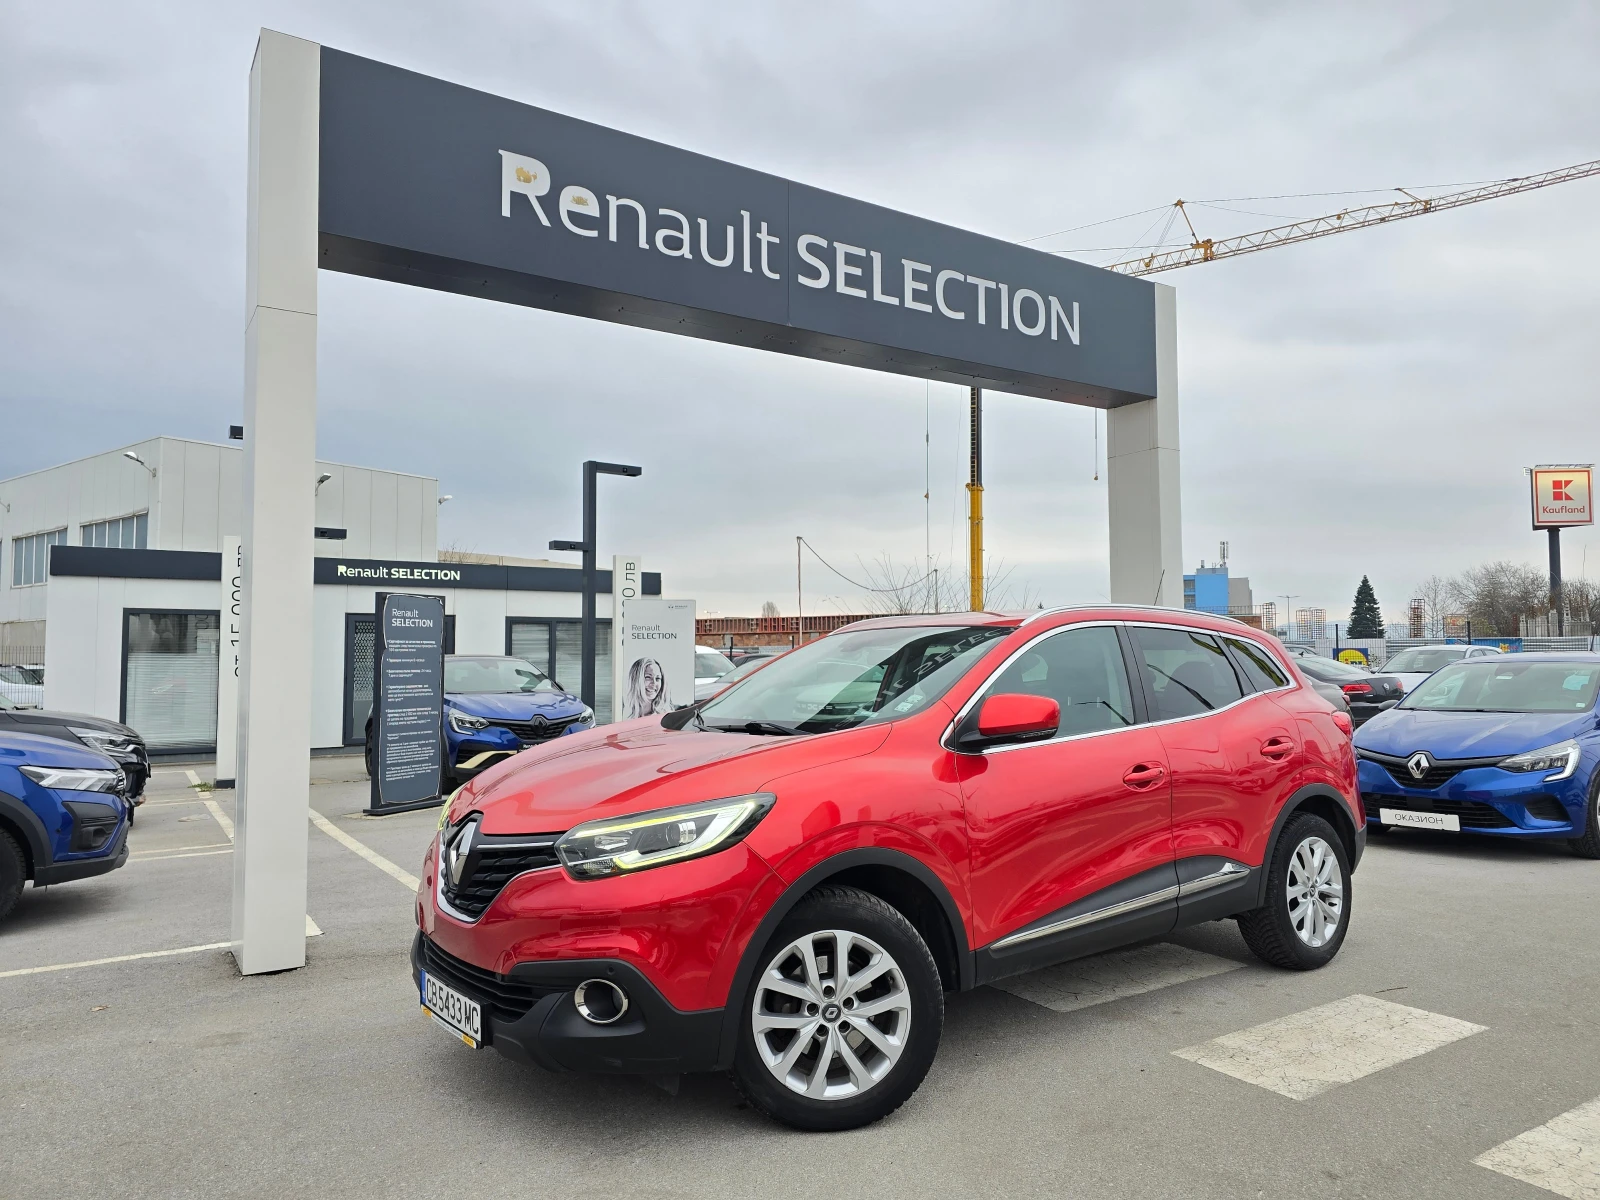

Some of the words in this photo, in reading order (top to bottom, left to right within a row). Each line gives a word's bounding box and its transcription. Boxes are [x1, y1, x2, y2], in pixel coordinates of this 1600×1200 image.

[498, 148, 780, 280] Renault
[796, 234, 1080, 345] SELECTION
[1542, 505, 1585, 514] Kaufland
[337, 564, 389, 578] Renault
[390, 567, 461, 581] SELECTION
[391, 608, 419, 618] Renault
[391, 618, 433, 628] SELECTION
[631, 624, 661, 632] Renault
[631, 632, 677, 640] SELECTION
[1394, 813, 1444, 825] ОКАЗИОН
